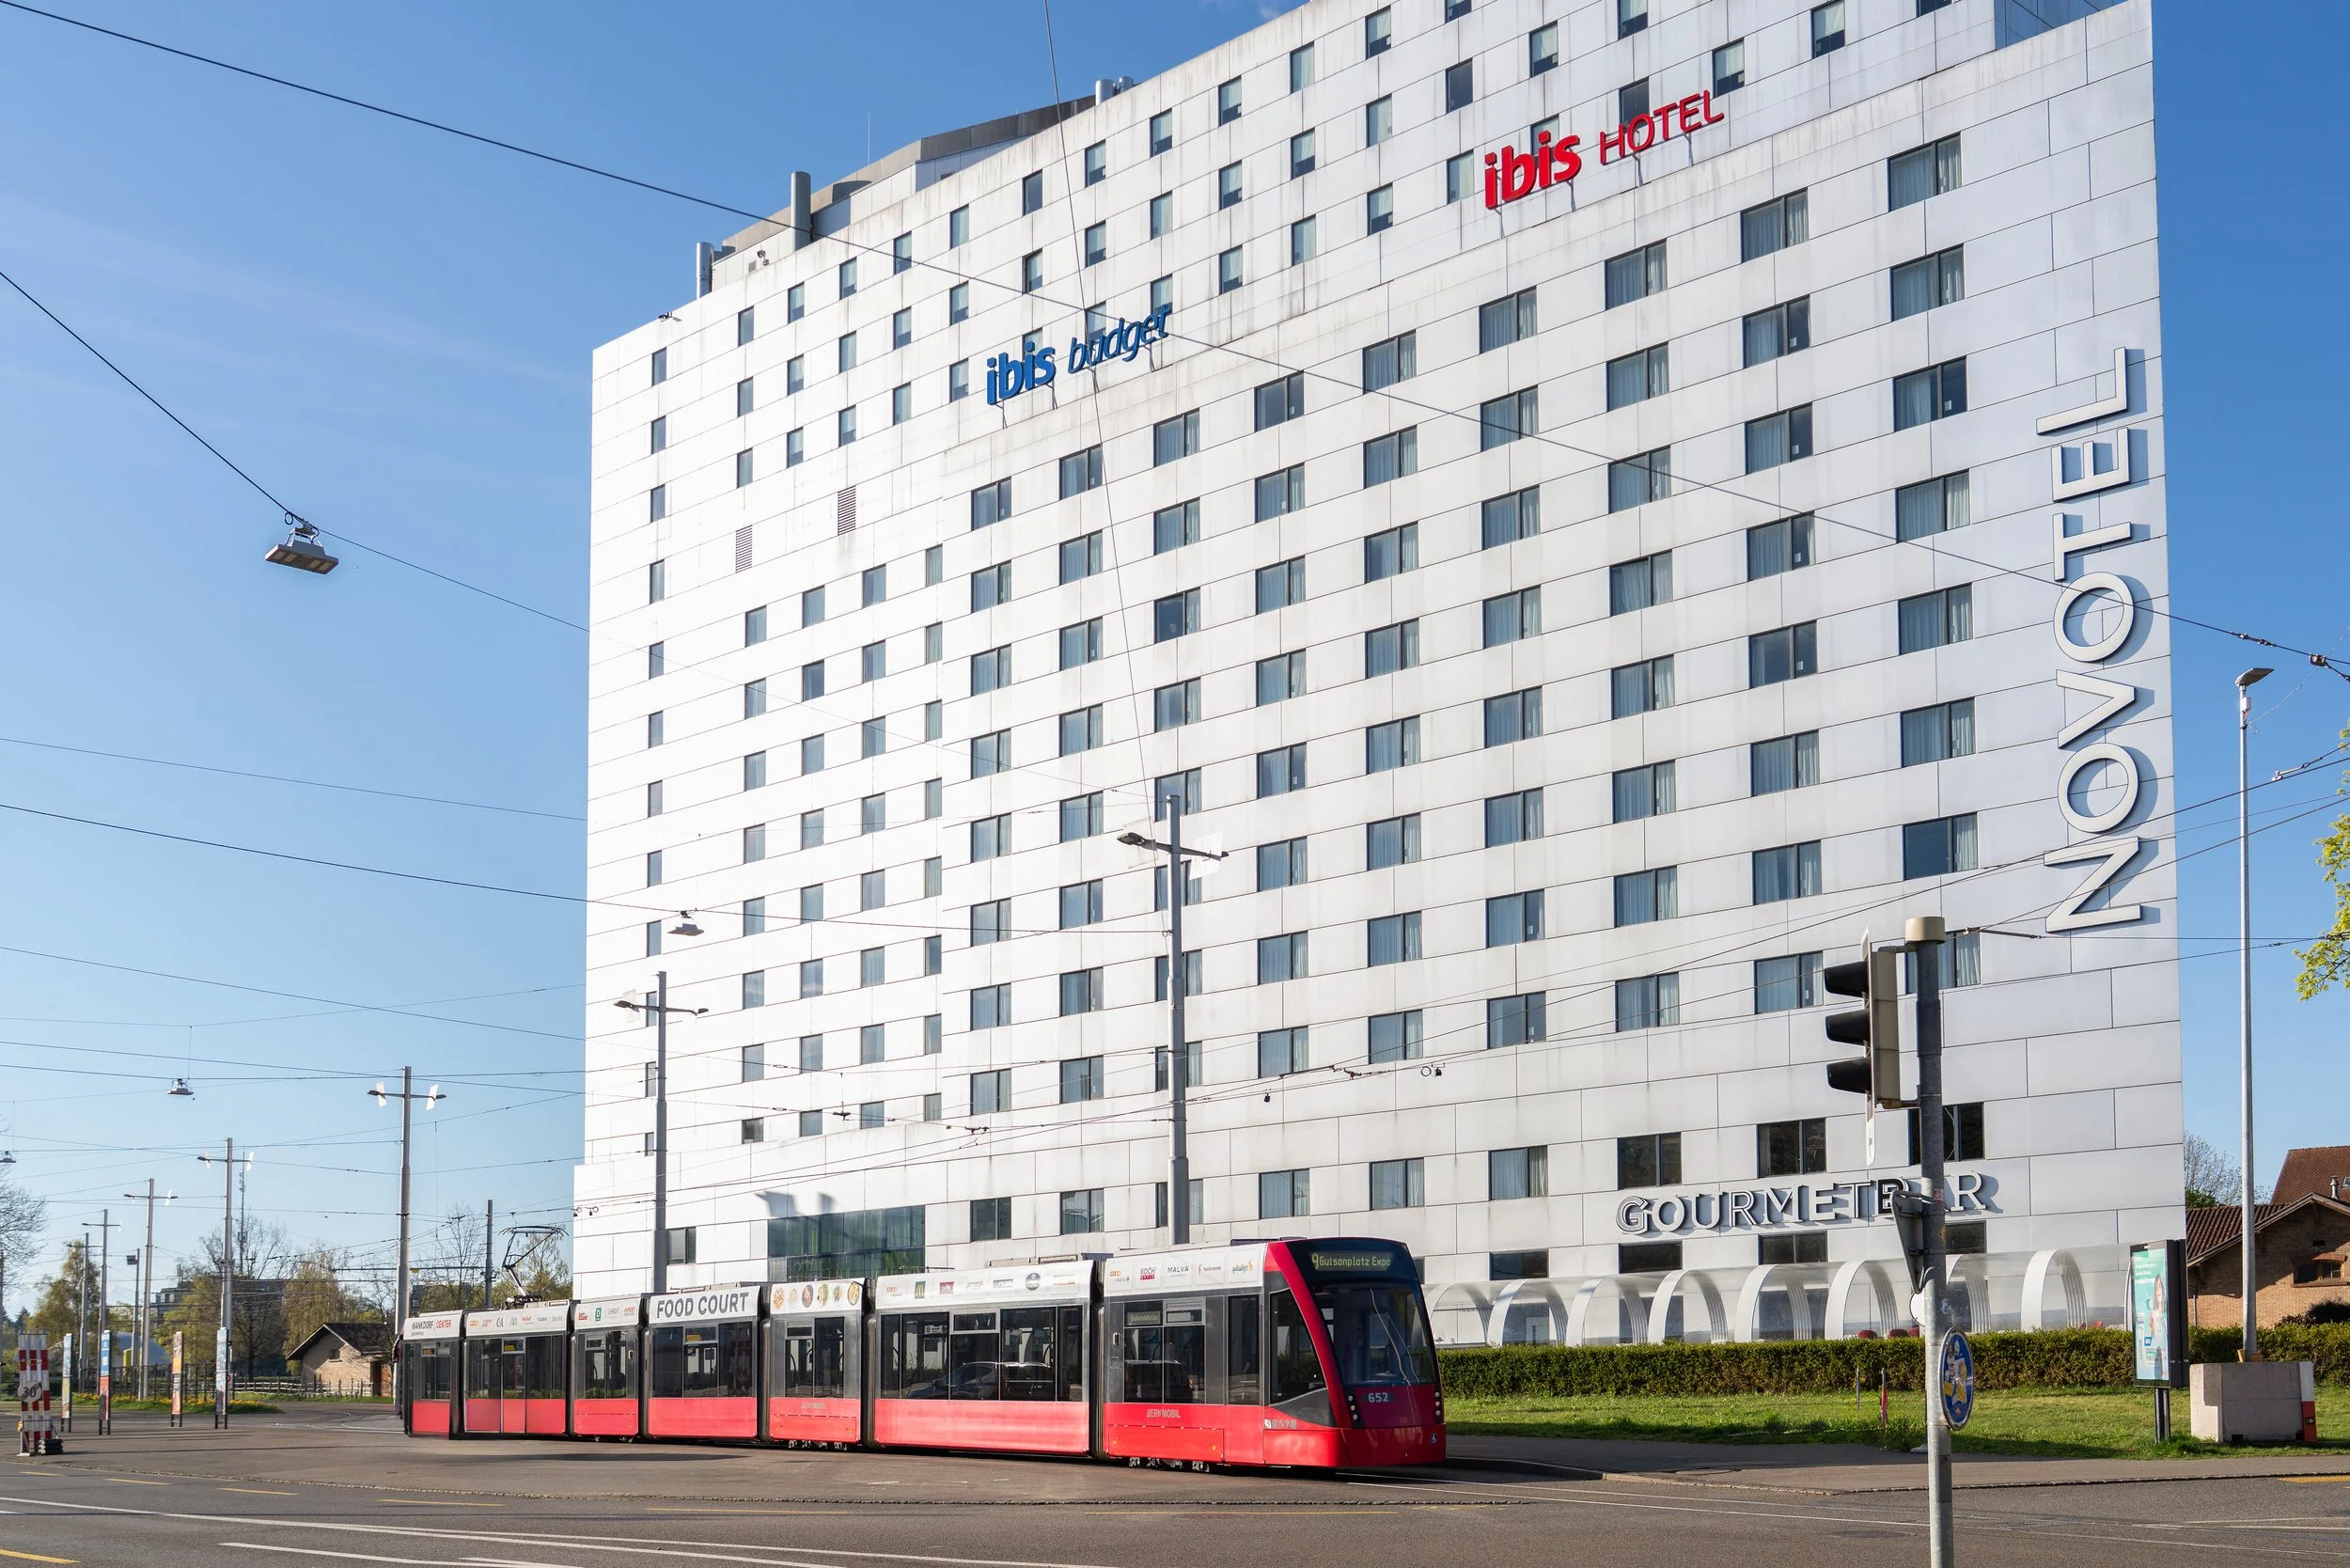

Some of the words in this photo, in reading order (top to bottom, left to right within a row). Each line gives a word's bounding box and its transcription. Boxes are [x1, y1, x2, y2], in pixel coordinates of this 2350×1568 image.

[1484, 130, 1583, 210] ibis
[1599, 88, 1726, 166] HOTEL
[986, 340, 1057, 406] ibis
[1068, 304, 1173, 375] budget
[2036, 345, 2143, 935] NOVOTEL
[1616, 1171, 1988, 1236] GOURMETBR
[1167, 1265, 1189, 1274] MALVA
[1311, 1252, 1319, 1270] 9
[1319, 1256, 1370, 1267] Guisanplatz
[1371, 1256, 1391, 1267] Expo
[1140, 1266, 1156, 1275] KOCH
[656, 1297, 694, 1319] FOOD
[697, 1292, 749, 1316] COURT
[435, 1318, 452, 1329] CENTER
[23, 1387, 37, 1398] 30
[1368, 1392, 1389, 1403] 652
